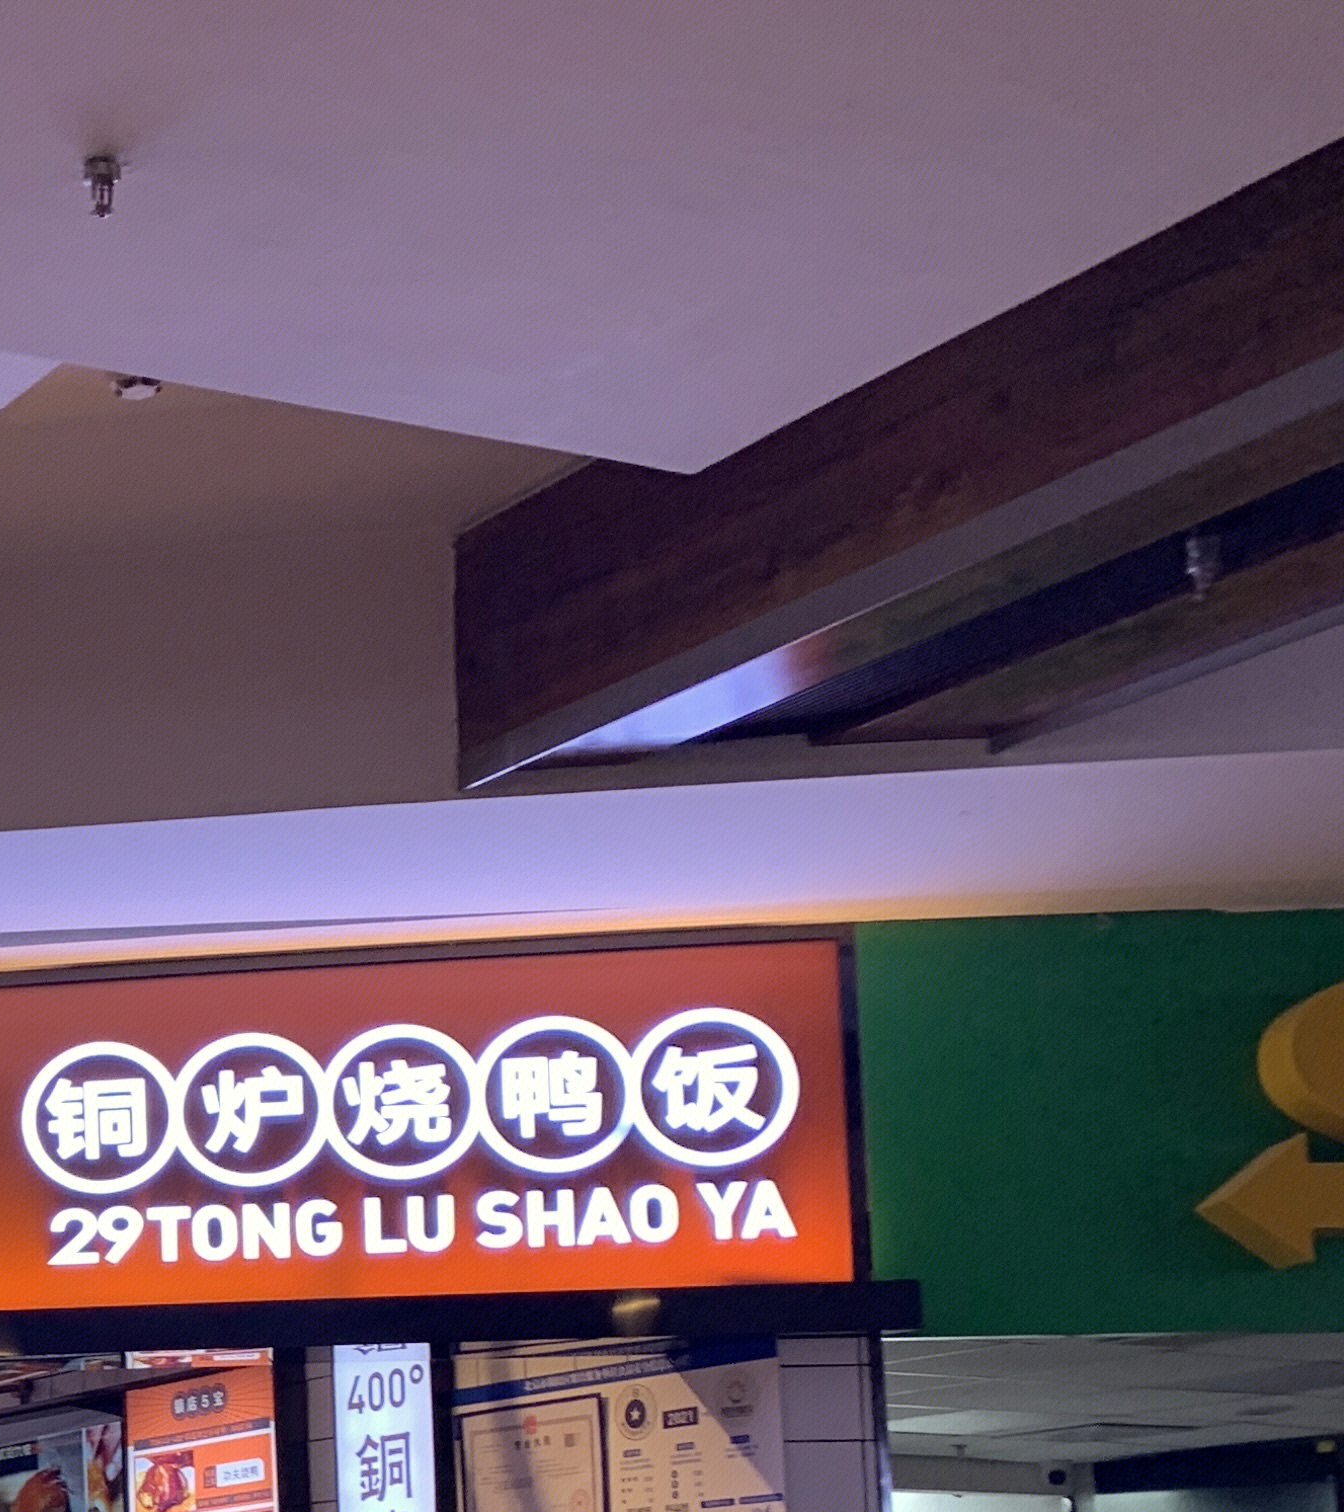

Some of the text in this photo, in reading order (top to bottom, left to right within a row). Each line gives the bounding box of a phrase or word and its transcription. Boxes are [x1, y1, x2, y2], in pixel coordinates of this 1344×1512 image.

[46, 1043, 765, 1161] 铜炉烧鸭饭
[46, 1181, 798, 1266] 29TONG LU SHAO YA
[348, 1364, 424, 1414] 400°
